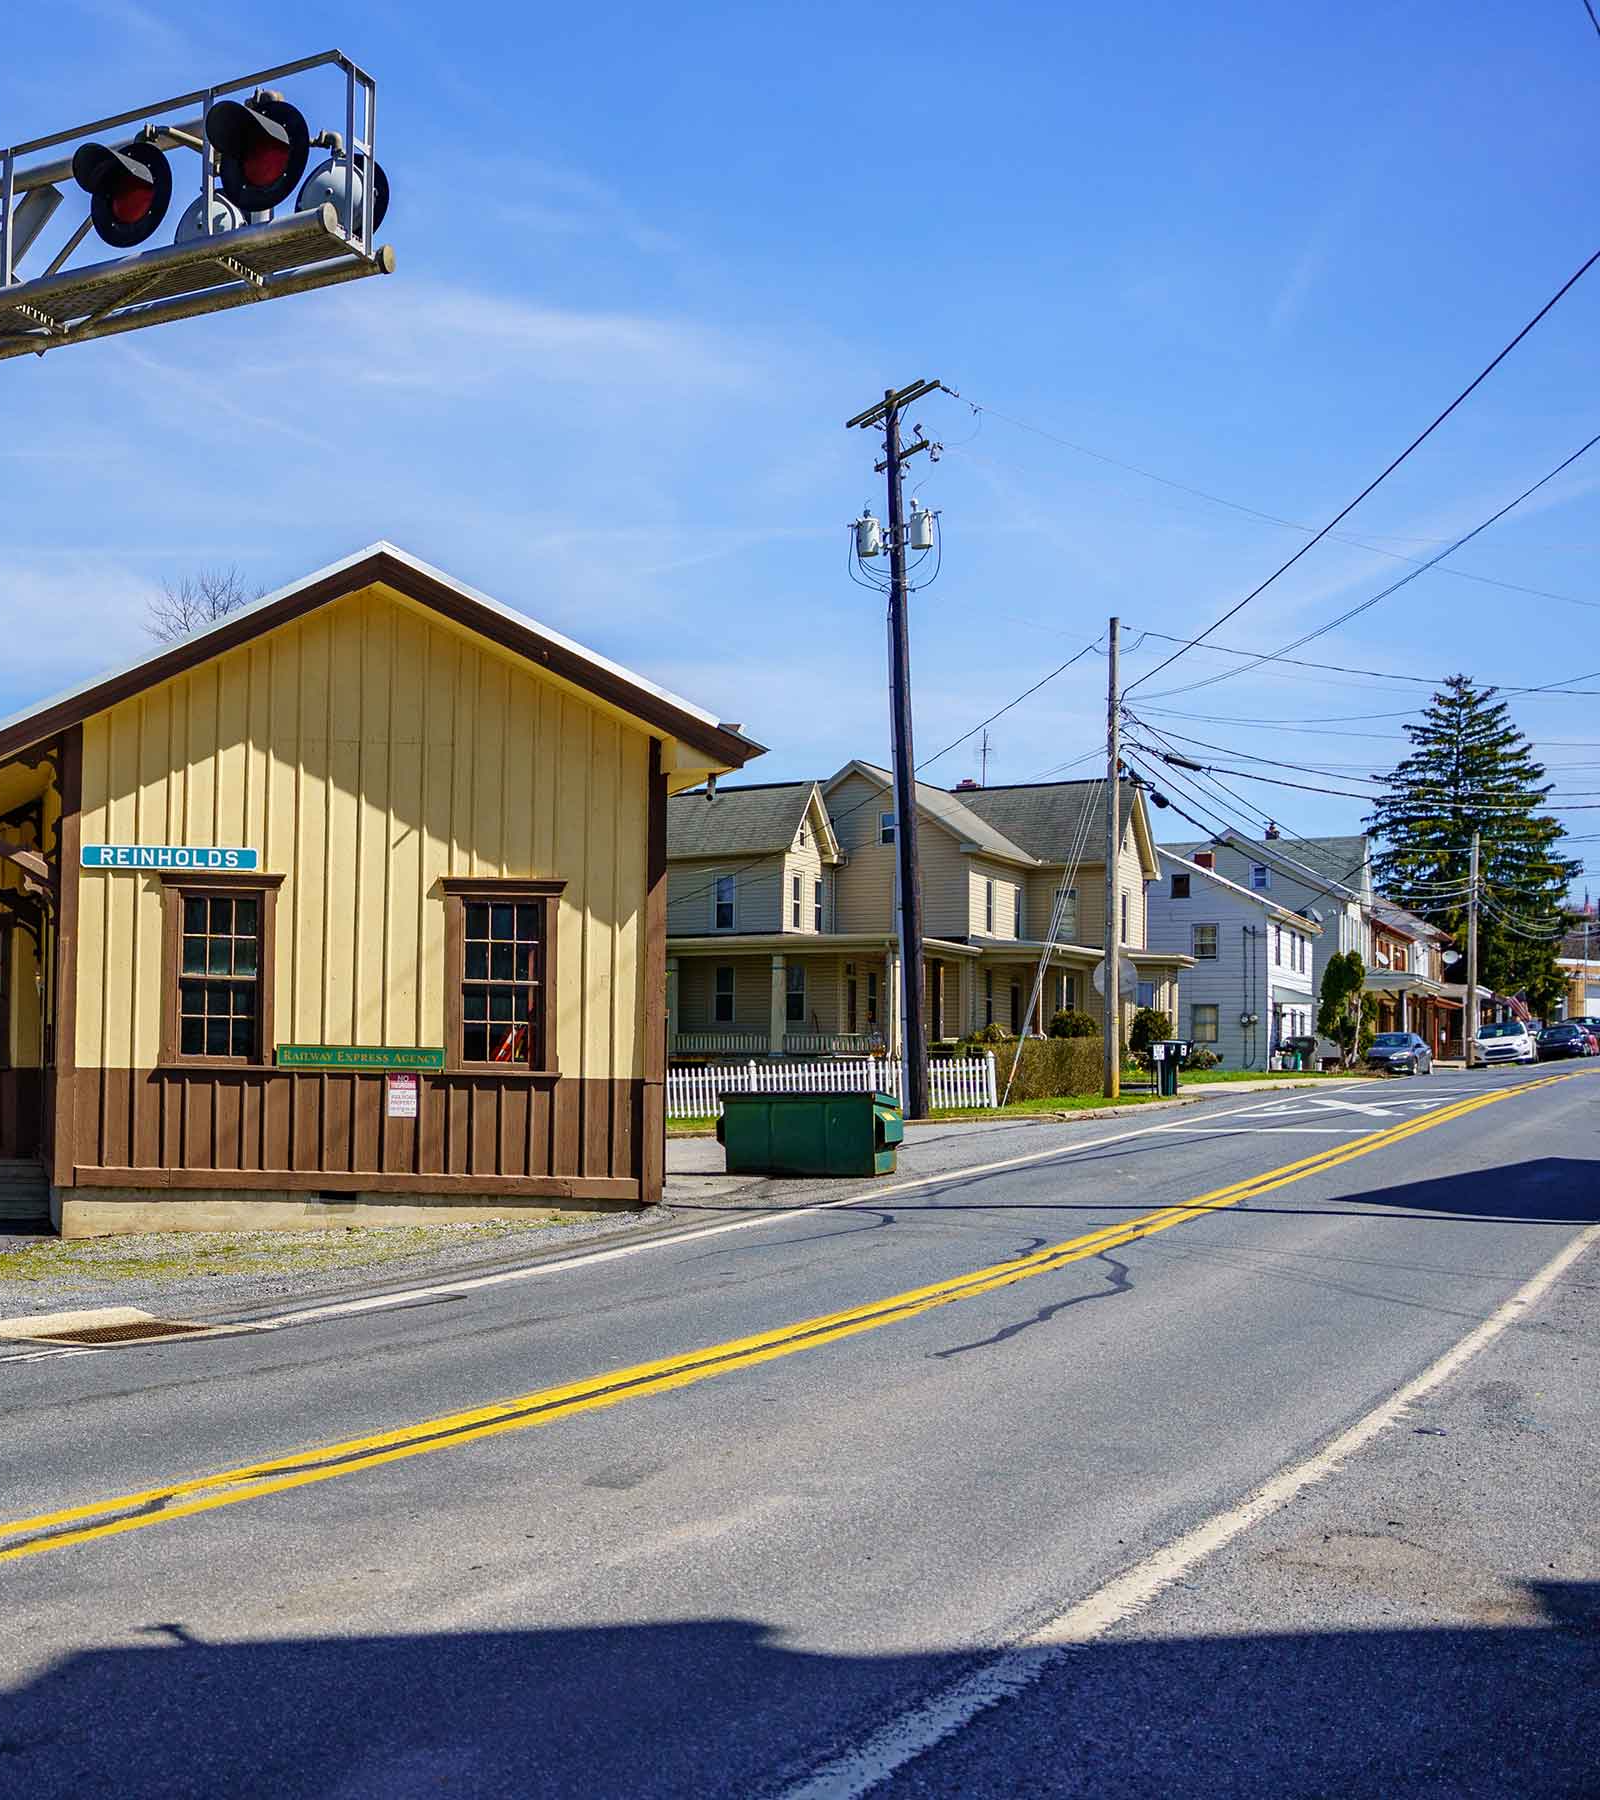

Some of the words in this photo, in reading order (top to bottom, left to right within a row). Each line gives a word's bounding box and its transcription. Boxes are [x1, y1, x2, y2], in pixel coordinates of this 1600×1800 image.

[99, 847, 240, 868] REINHOLDS
[283, 1050, 334, 1062] RAILWAY
[337, 1051, 389, 1063] EXPRESS
[393, 1053, 438, 1064] AGENCY
[397, 1074, 409, 1082] NO
